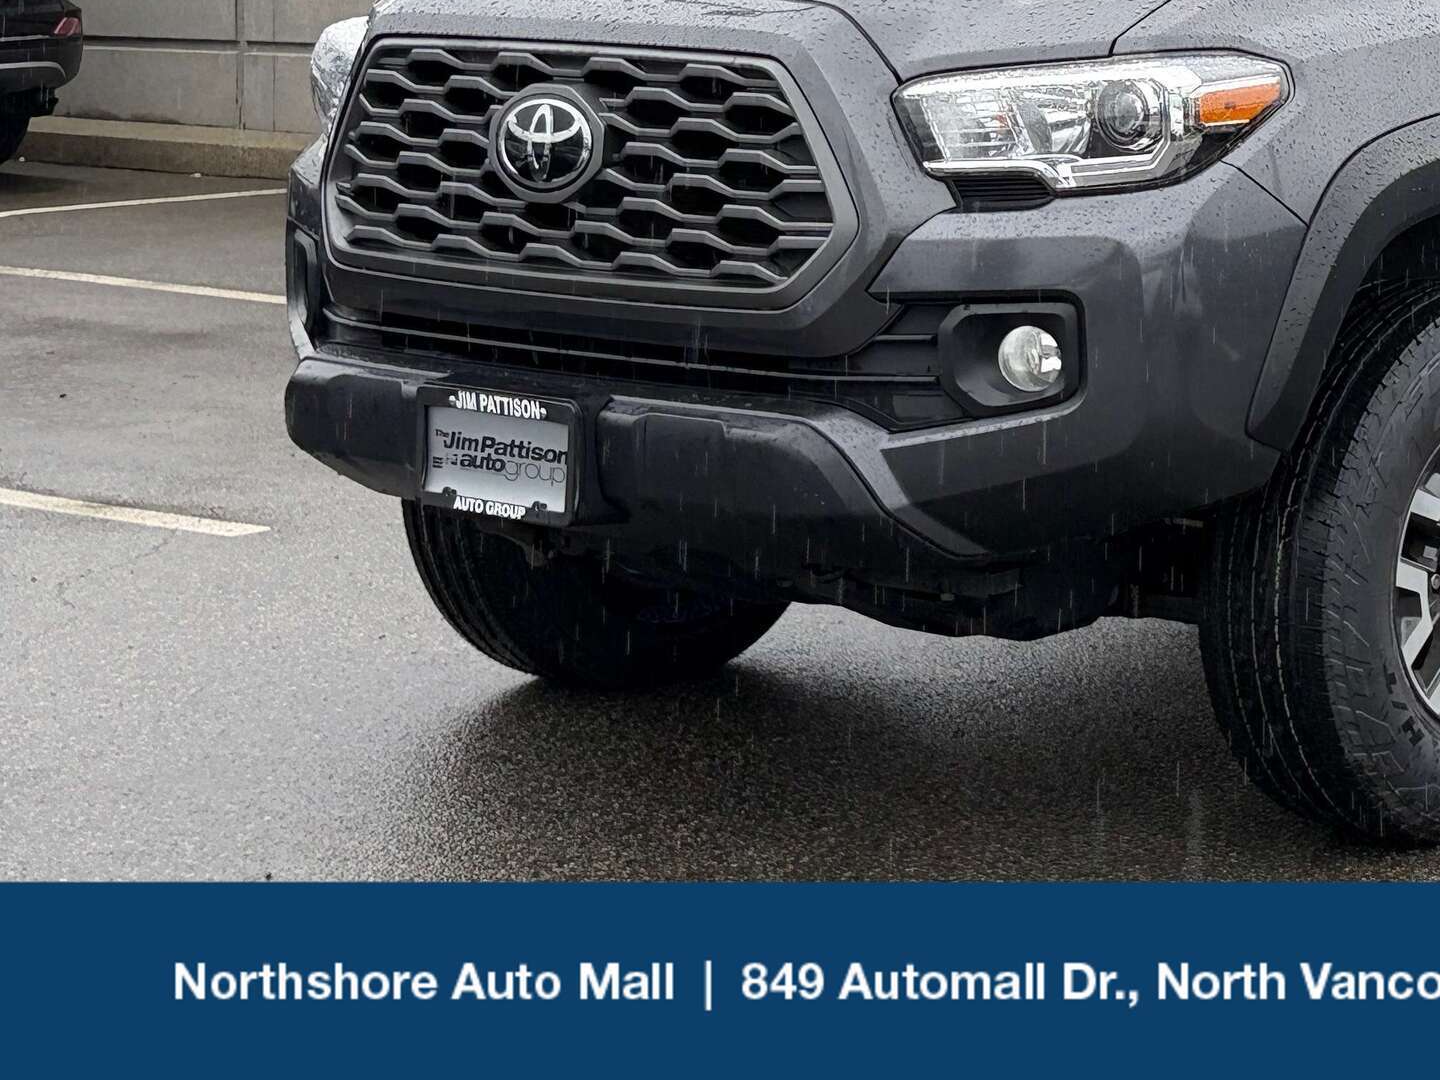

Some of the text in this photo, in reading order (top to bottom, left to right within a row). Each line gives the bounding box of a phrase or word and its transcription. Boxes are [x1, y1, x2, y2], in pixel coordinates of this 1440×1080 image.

[455, 390, 540, 420] JIM PATTISON
[443, 431, 479, 452] Jim
[453, 496, 527, 520] AUTO GROUP
